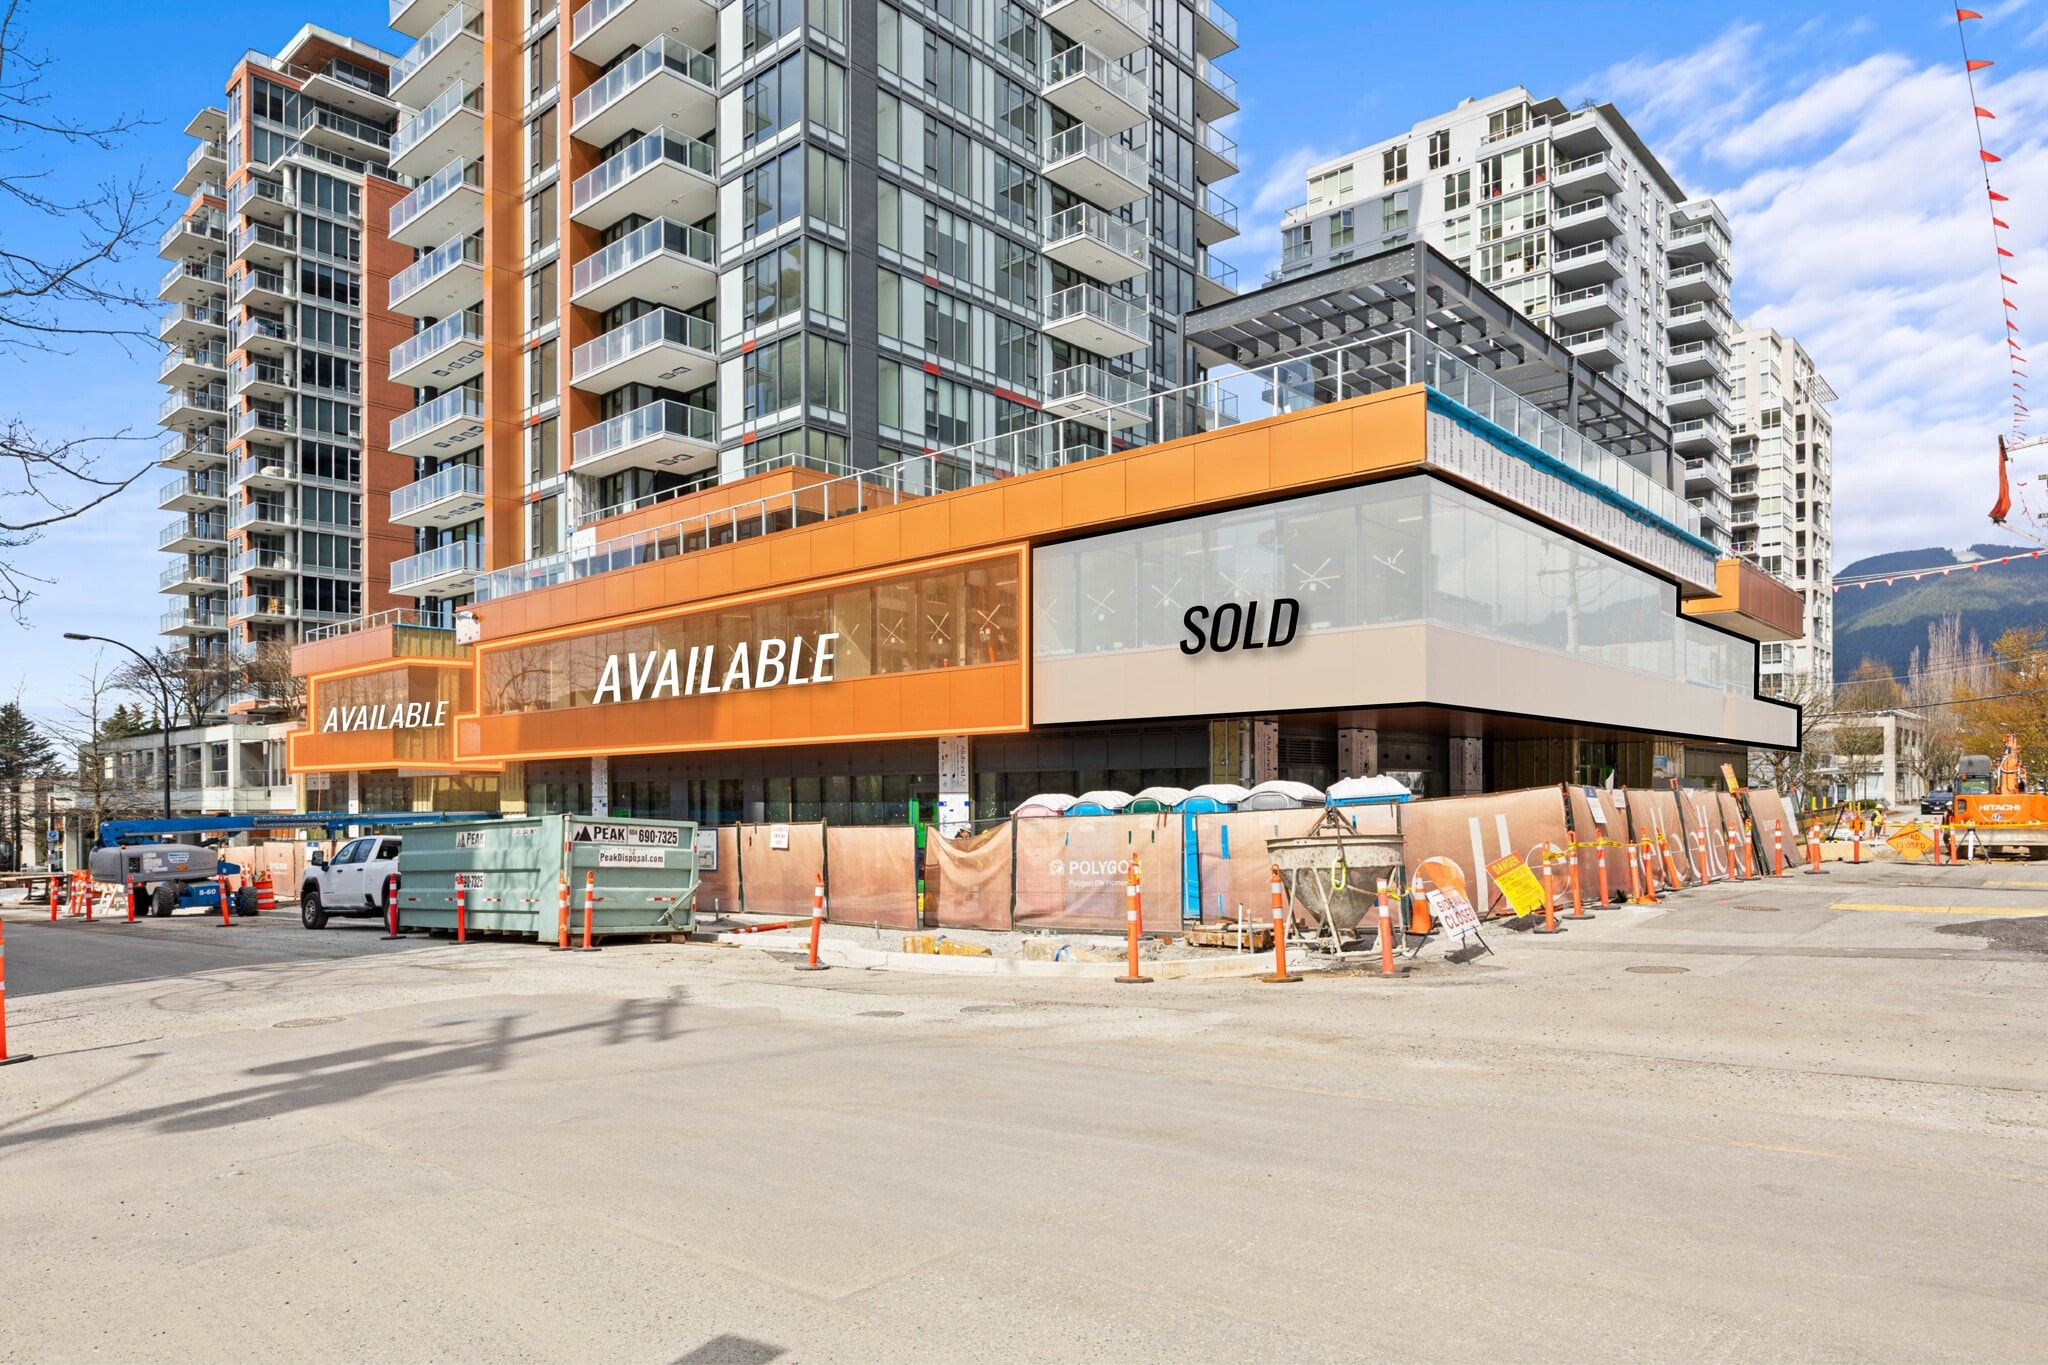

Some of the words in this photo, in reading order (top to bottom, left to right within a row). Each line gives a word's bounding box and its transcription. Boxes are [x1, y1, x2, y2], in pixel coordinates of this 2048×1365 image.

[466, 832, 484, 846] PEAK
[594, 826, 625, 841] PEAK
[638, 829, 678, 845] 690-7325
[600, 852, 664, 863] PeakDisposal.com
[1491, 855, 1520, 875] DANGER
[1437, 896, 1469, 913] SIDEWA
[1444, 907, 1476, 930] CLOSED
